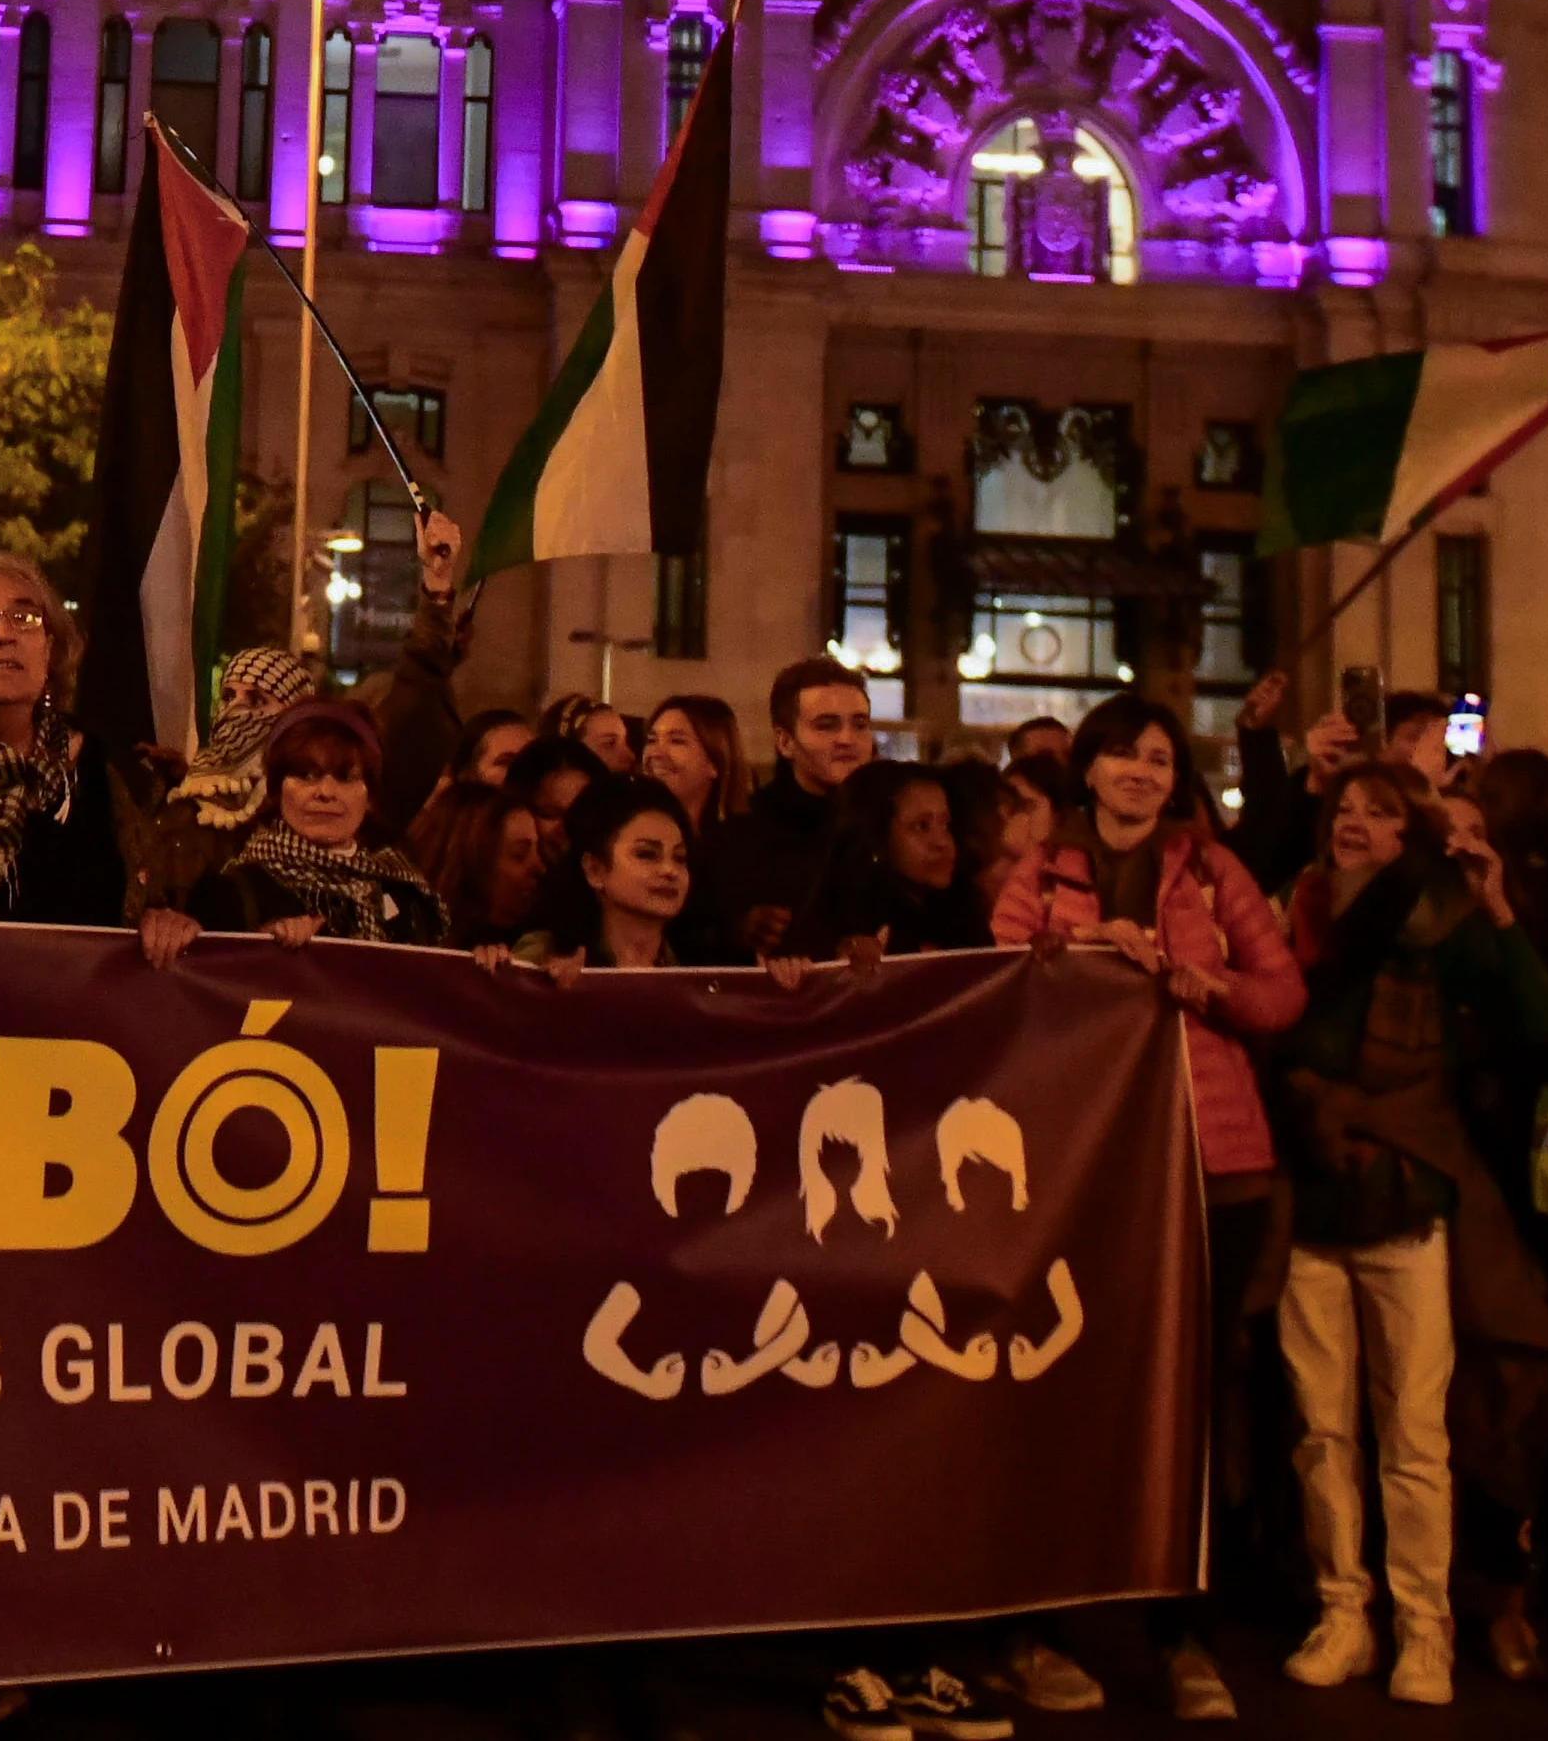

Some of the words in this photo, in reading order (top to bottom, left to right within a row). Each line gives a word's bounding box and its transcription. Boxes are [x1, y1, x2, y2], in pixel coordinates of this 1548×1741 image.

[41, 1321, 408, 1404] GLOBAL
[53, 1489, 131, 1550] DE
[157, 1478, 407, 1545] MADRID
